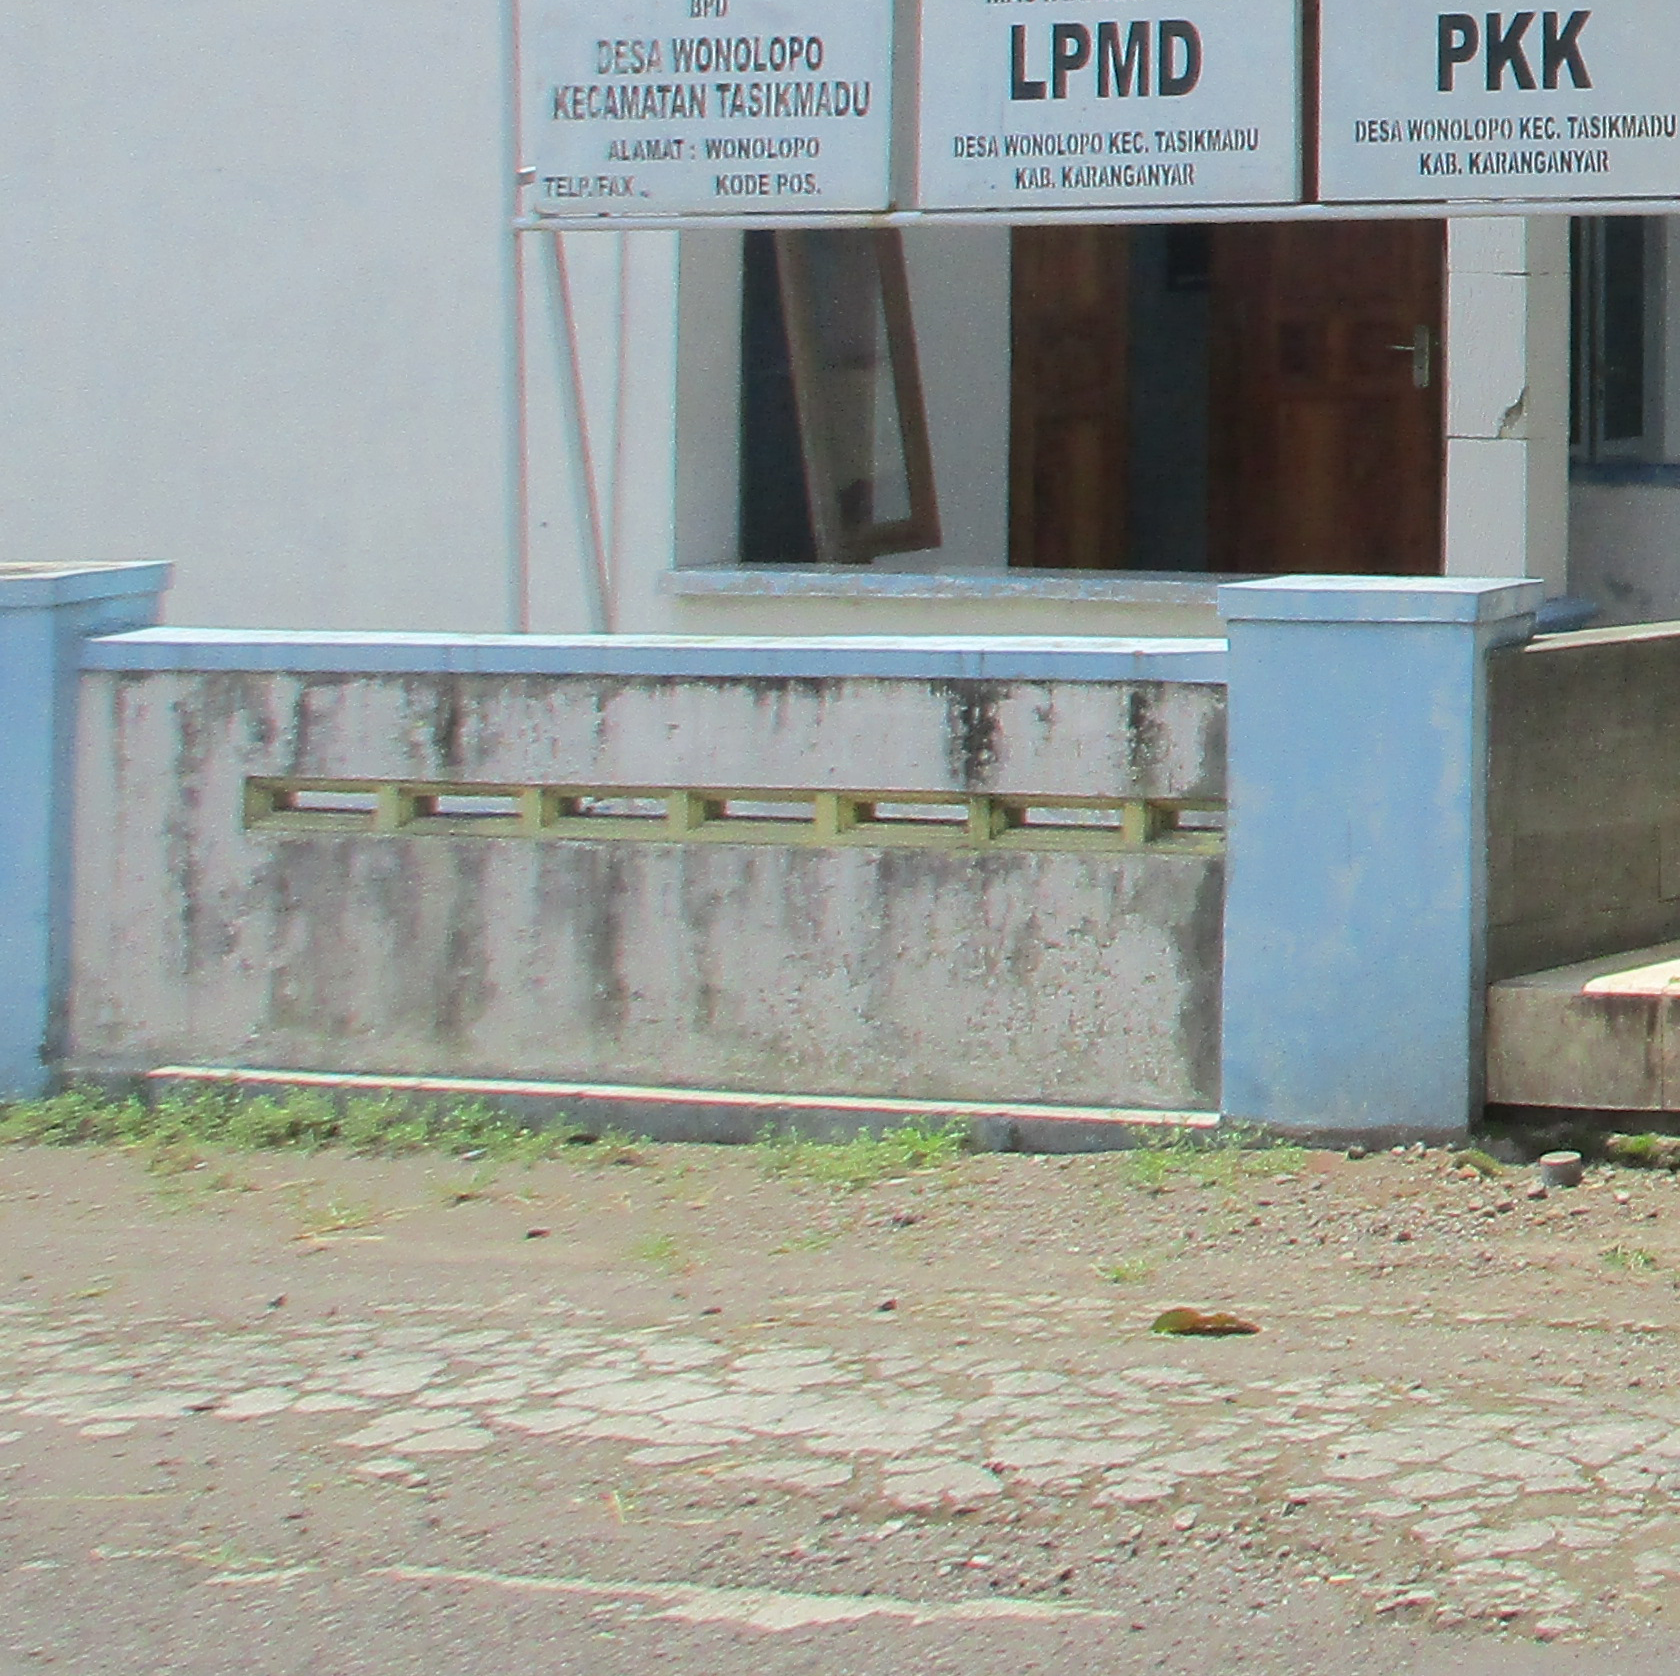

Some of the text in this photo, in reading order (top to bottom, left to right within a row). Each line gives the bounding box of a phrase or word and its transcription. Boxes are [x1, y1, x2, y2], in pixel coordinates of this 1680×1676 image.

[596, 36, 823, 75] DESA WONOLOPO
[1010, 19, 1201, 101] LPMD
[1437, 10, 1592, 92] PKK
[553, 81, 870, 121] KECAMATAN TASIKMADU
[953, 128, 1259, 158] DESA WONOLOPO KEC. TASIKMADU
[1355, 114, 1676, 143] DESA WONOLOPO KEC. TASIKMADU
[607, 138, 685, 162] ALAMAT
[704, 136, 820, 160] WONOLOPO
[1419, 149, 1608, 176] KAB. KARANGANYAR
[715, 173, 770, 196] KODE
[776, 172, 821, 195] POS.
[1014, 163, 1195, 190] KAB. KARANGANYAR
